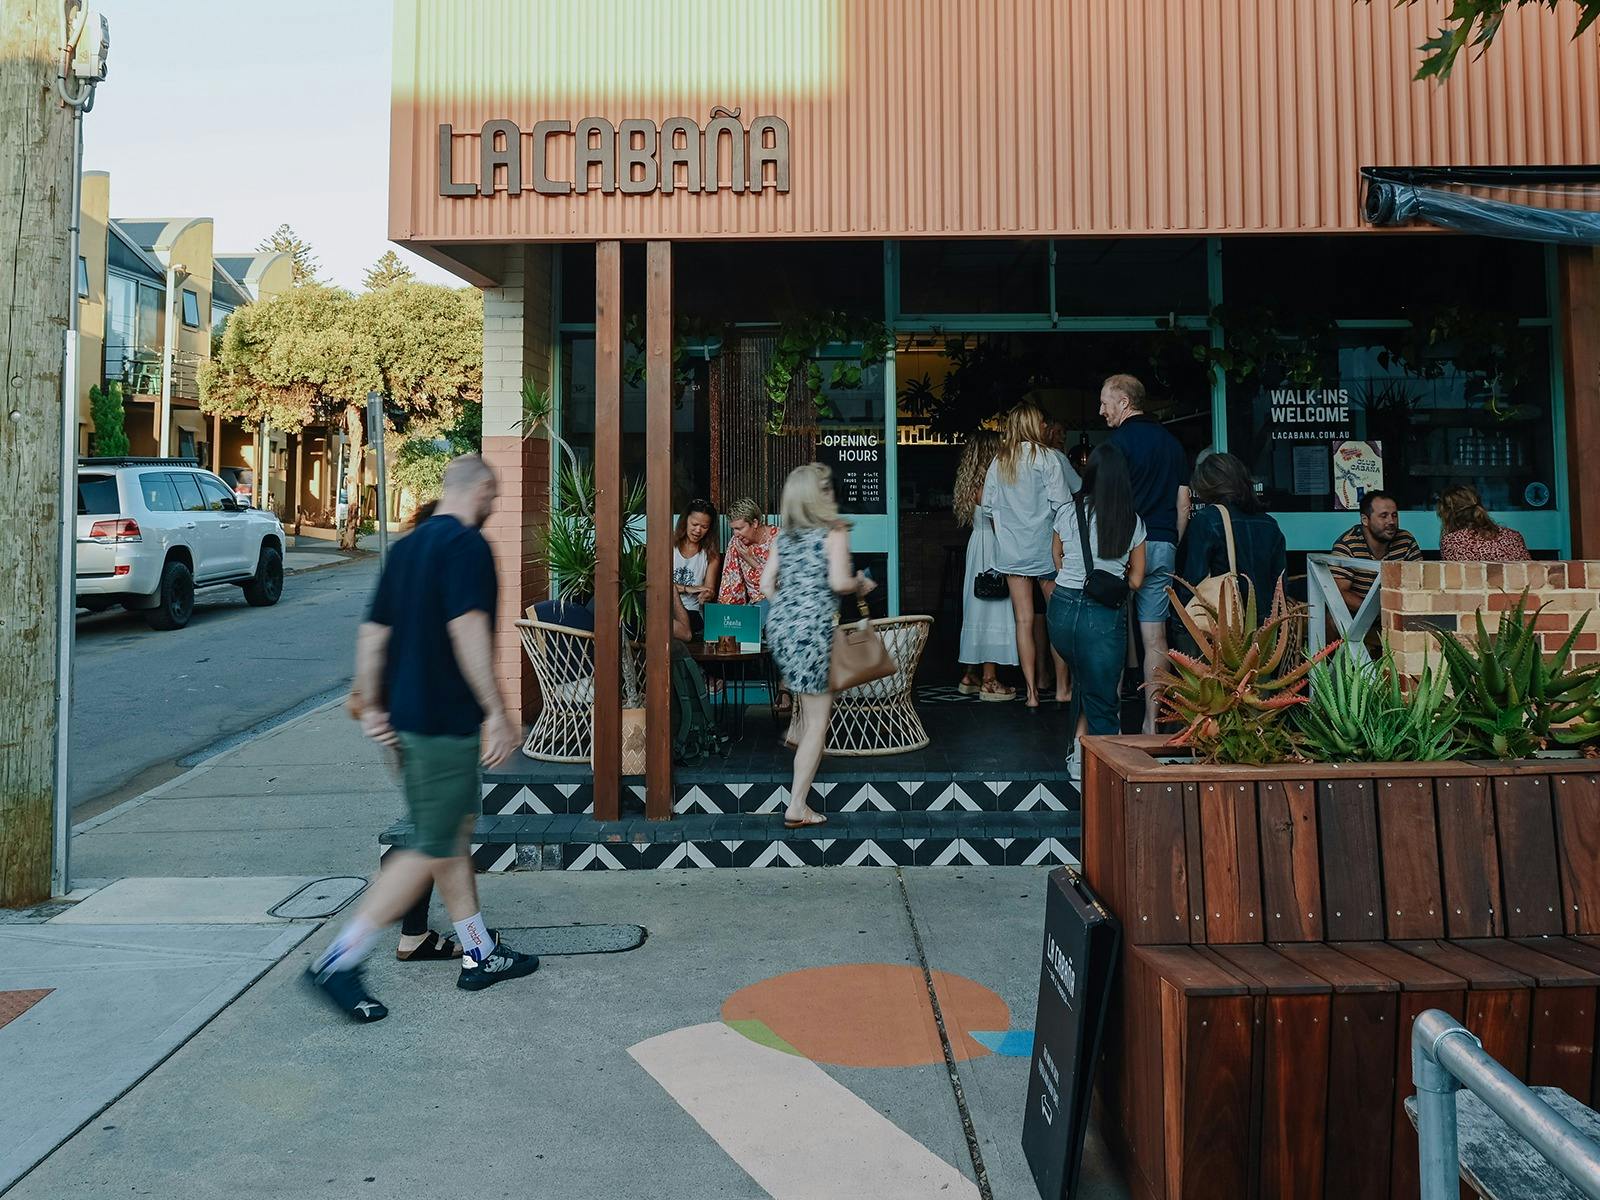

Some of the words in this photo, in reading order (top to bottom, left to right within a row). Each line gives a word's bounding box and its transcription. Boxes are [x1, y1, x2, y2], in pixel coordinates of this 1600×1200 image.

[439, 119, 521, 197] LA
[532, 105, 790, 196] CABAÑA
[1271, 389, 1348, 405] WALK-INS
[1271, 407, 1349, 422] WELCOME
[824, 435, 878, 447] OPENING
[1272, 431, 1350, 440] LACABANA.COM.AU
[839, 449, 878, 462] HOURS
[1357, 459, 1376, 467] CLUB
